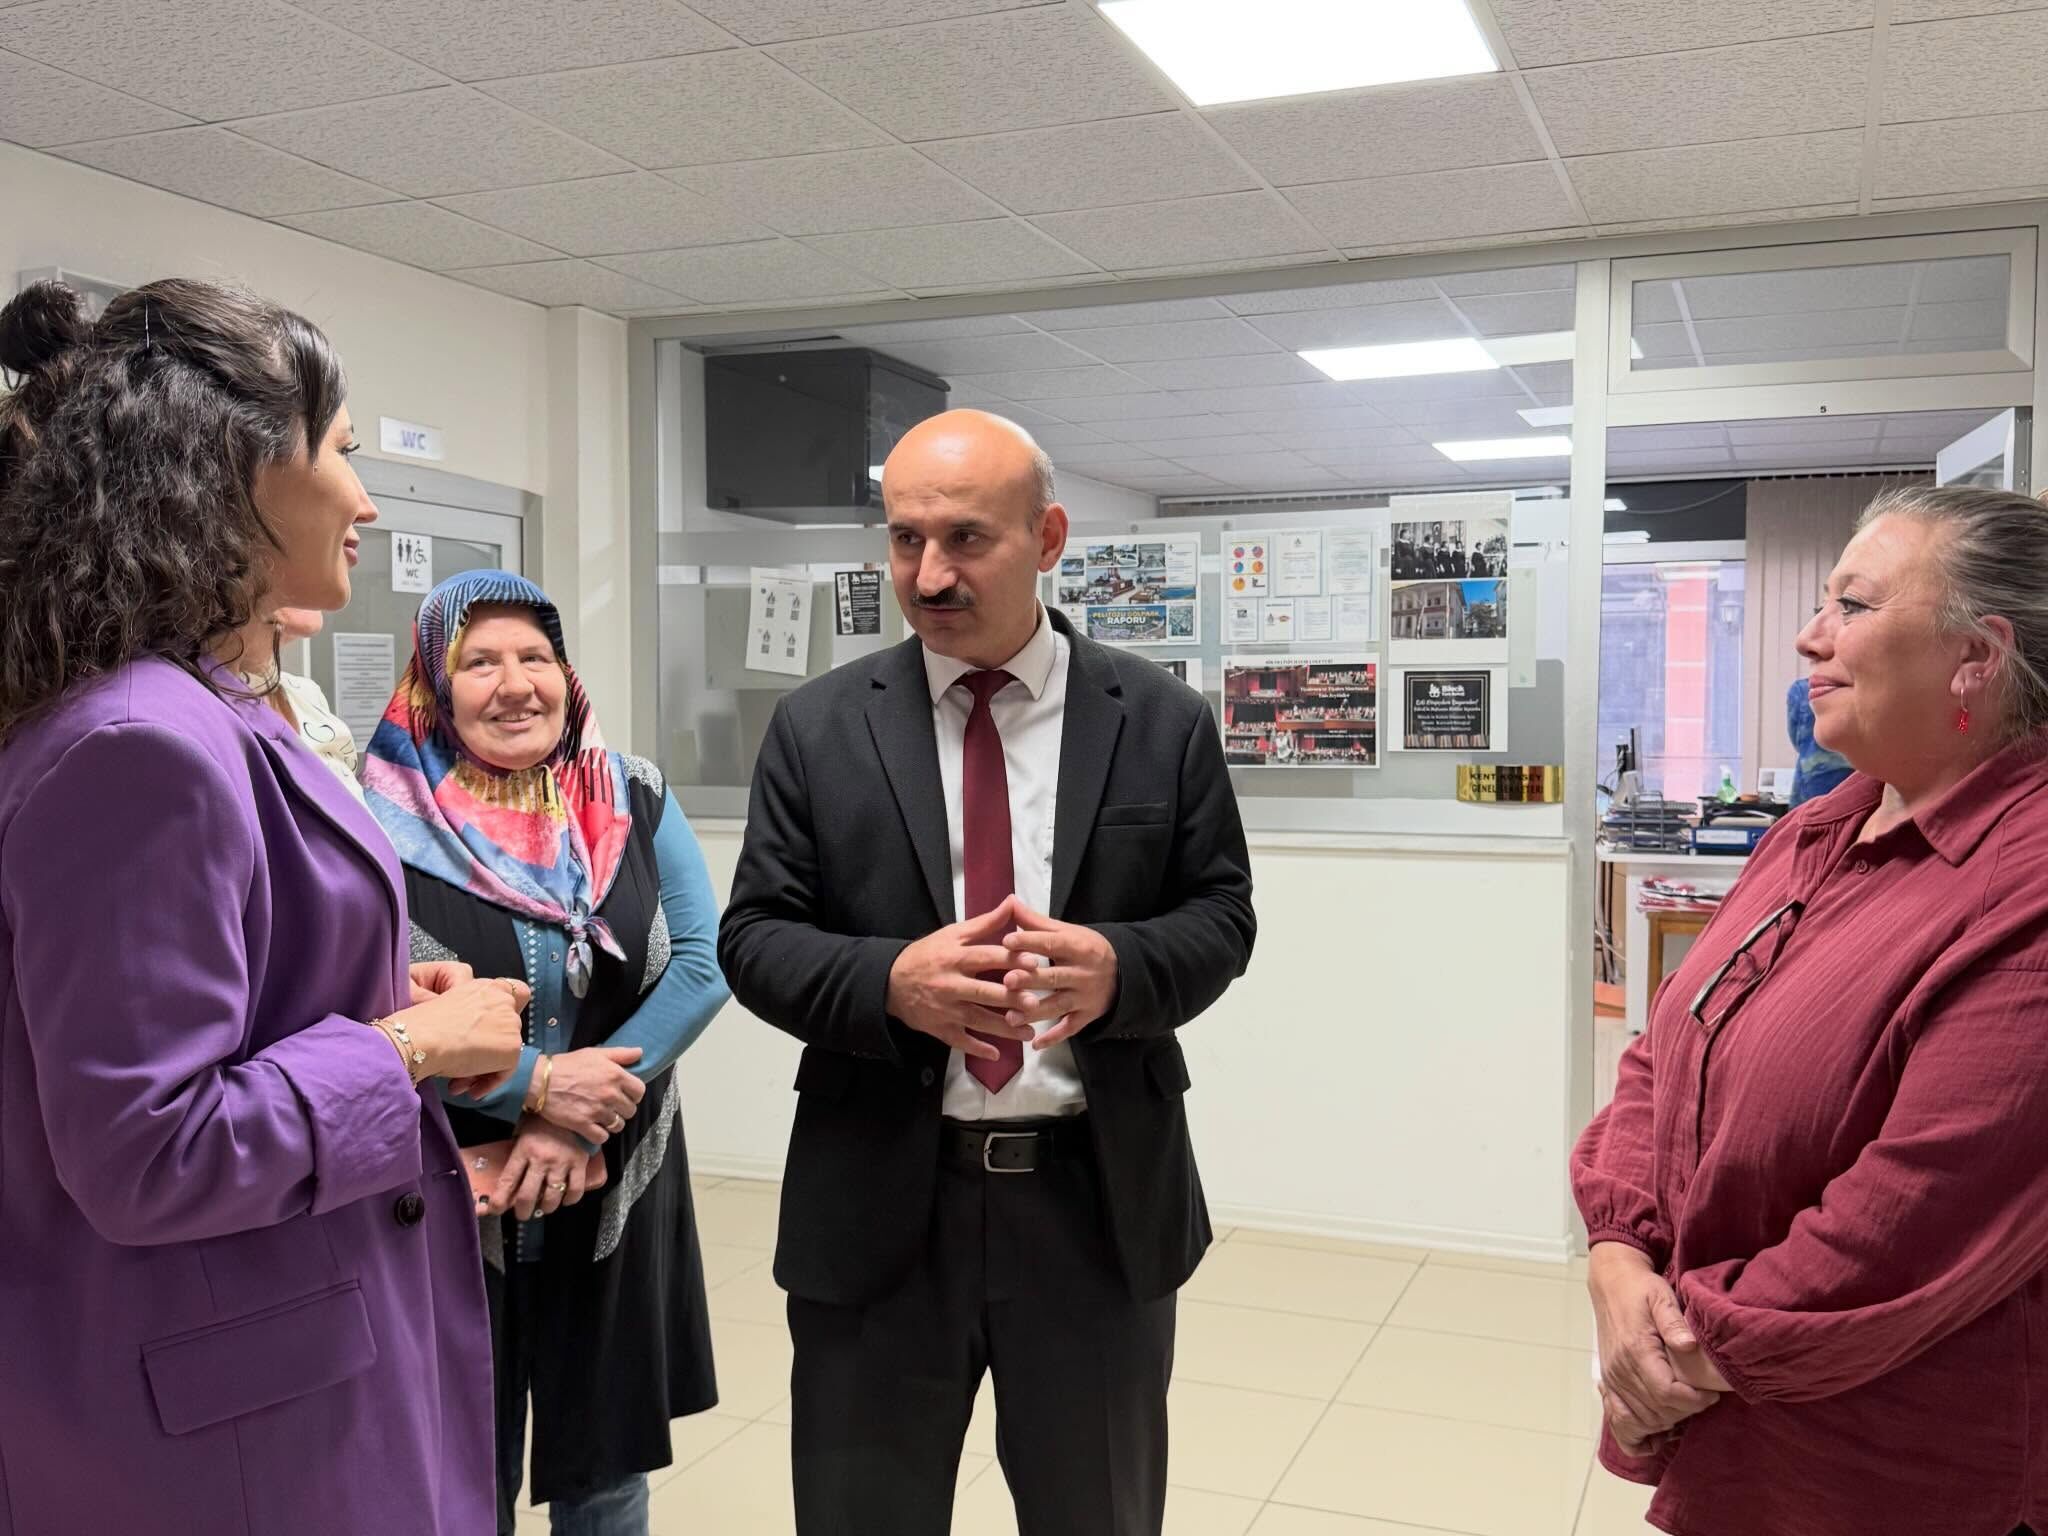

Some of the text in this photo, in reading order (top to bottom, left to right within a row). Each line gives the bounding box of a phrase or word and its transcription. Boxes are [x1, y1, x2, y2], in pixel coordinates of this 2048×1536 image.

[401, 429, 426, 450] WC
[406, 568, 420, 579] WC
[1107, 616, 1146, 624] RAPORU
[1470, 773, 1496, 781] KENT
[1471, 784, 1496, 793] GENEL
